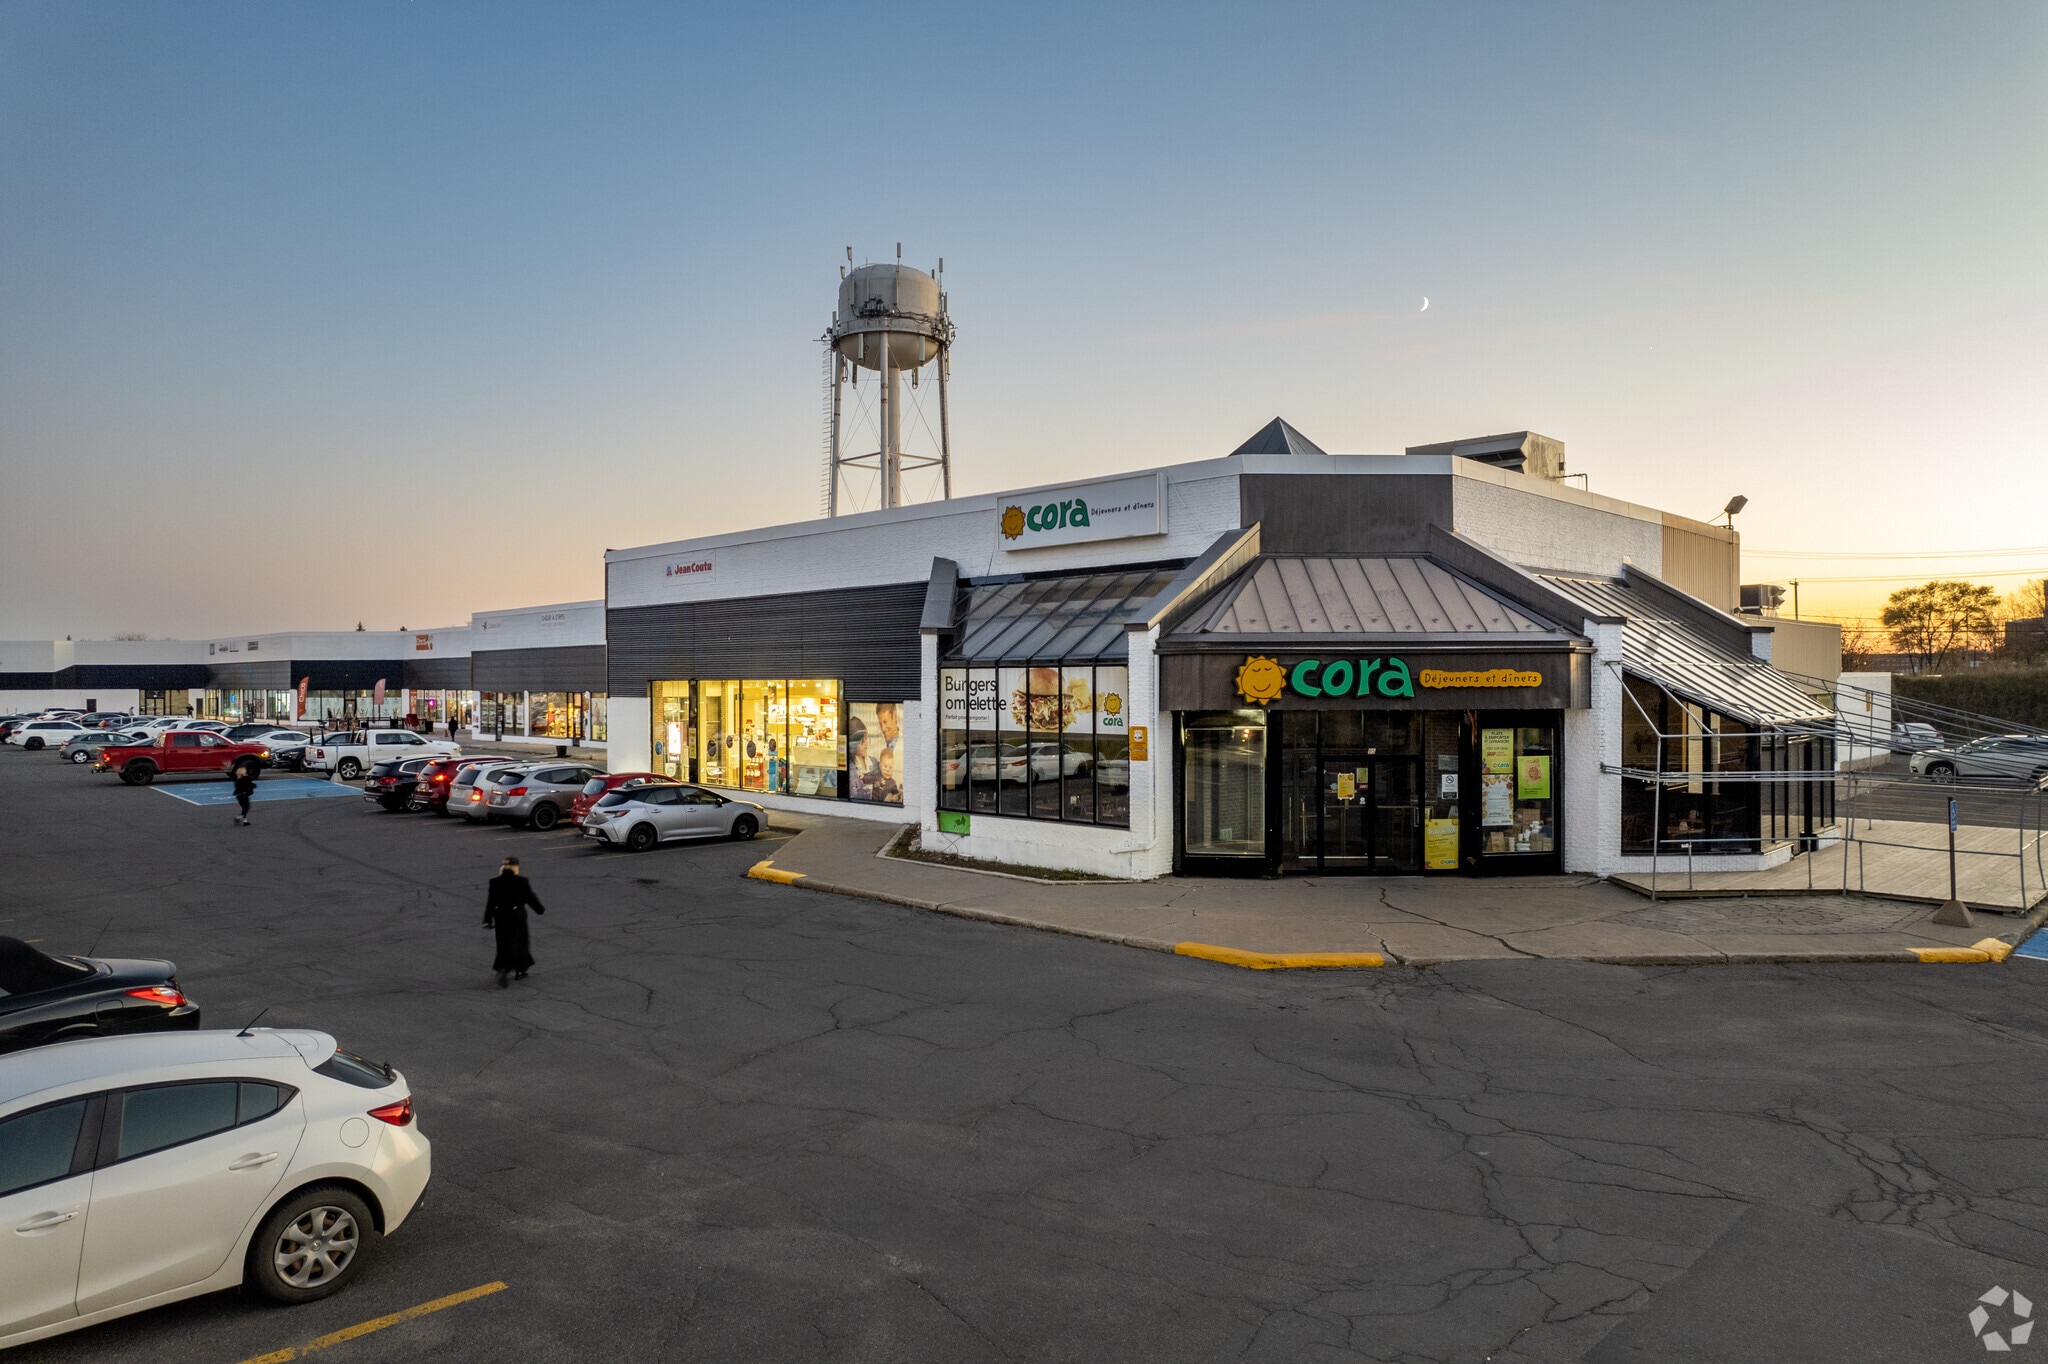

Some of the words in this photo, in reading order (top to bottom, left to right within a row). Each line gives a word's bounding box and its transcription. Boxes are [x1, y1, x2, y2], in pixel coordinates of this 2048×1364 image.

[1027, 498, 1090, 532] cora
[1091, 507, 1121, 516] Déjeuners
[1133, 502, 1154, 510] dîners
[674, 564, 691, 575] Jean
[691, 561, 712, 572] Coutu
[945, 675, 997, 696] Burgers
[1291, 657, 1415, 698] cora
[1424, 673, 1480, 685] Déjeuners
[1486, 674, 1496, 683] et
[1502, 673, 1538, 682] dîners
[945, 696, 1007, 711] omelette
[1102, 717, 1124, 727] cora
